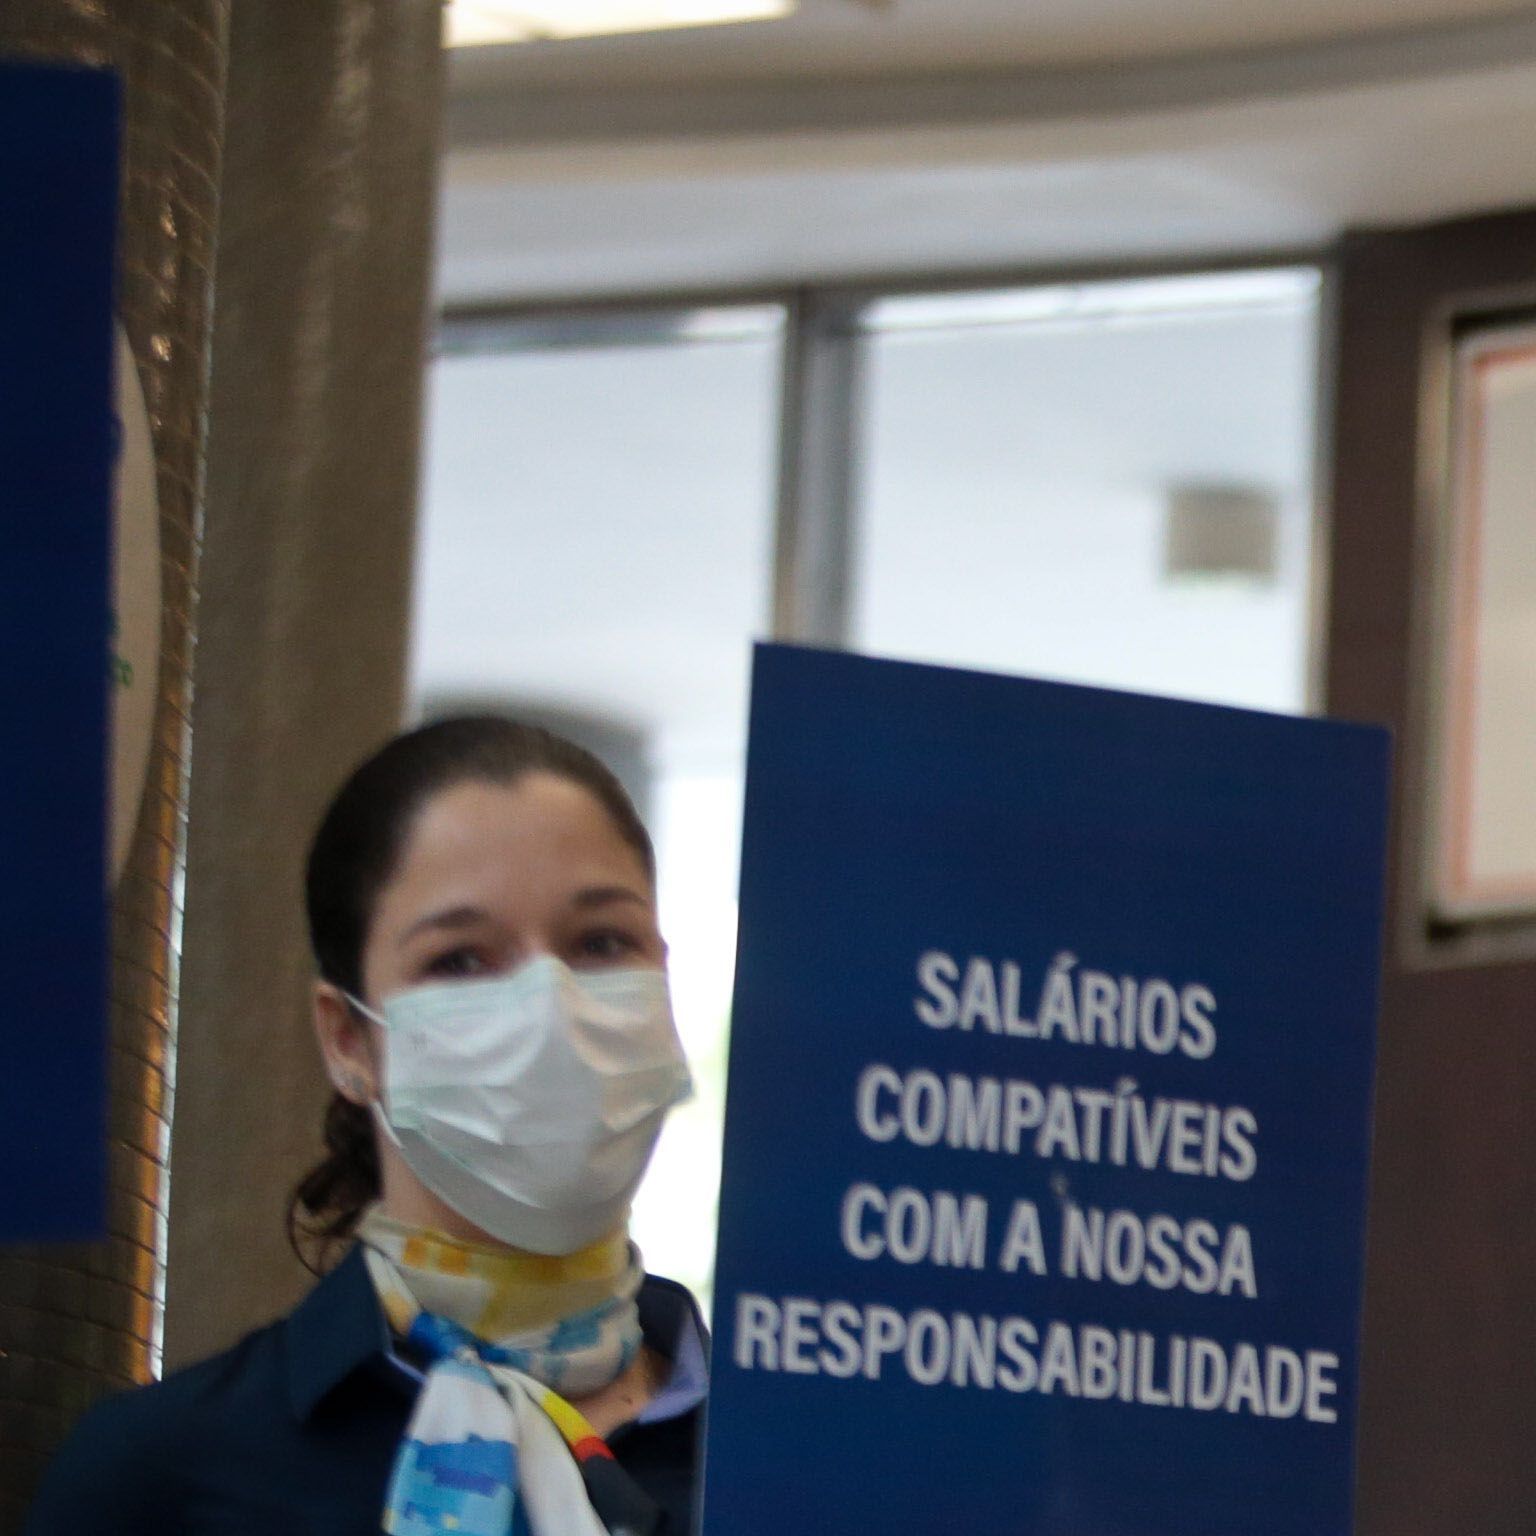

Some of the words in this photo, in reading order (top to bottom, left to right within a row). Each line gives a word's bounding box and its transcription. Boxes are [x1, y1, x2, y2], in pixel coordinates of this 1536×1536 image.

[916, 951, 1217, 1058] SALÁRIOS
[858, 1065, 1258, 1182] COMPATÍVEIS
[842, 1184, 988, 1268] COM
[1002, 1202, 1047, 1275] A
[1063, 1205, 1258, 1298] NOSSA
[735, 1294, 1339, 1424] RESPONSABILIDADE
